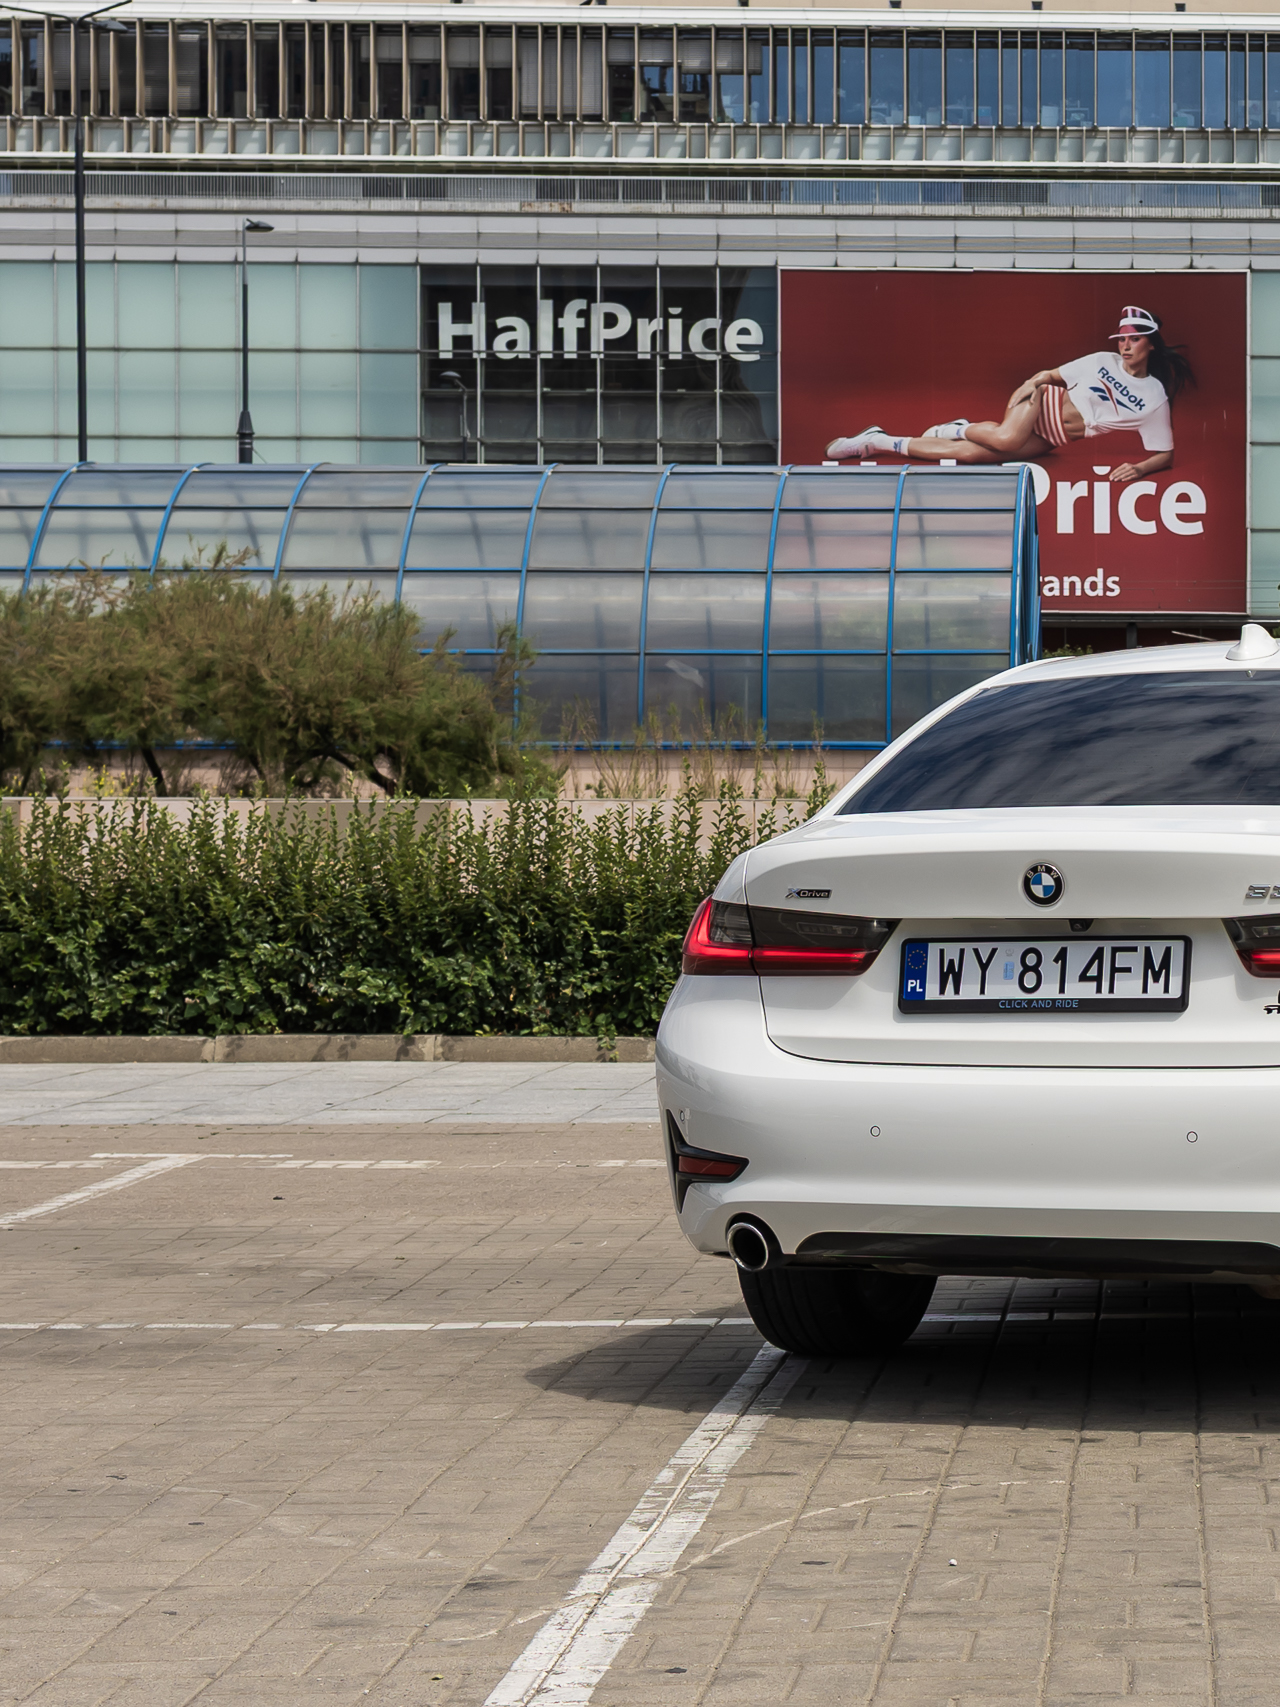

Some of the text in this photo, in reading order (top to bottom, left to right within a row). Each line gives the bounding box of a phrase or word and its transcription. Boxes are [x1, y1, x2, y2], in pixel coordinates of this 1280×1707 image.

[436, 299, 765, 363] HalfPrice
[1097, 366, 1146, 411] Reebok
[1026, 865, 1059, 879] BMW
[938, 945, 1173, 996] WY 814FM
[907, 979, 924, 993] PL
[998, 999, 1079, 1009] CLICK AND RIDE
